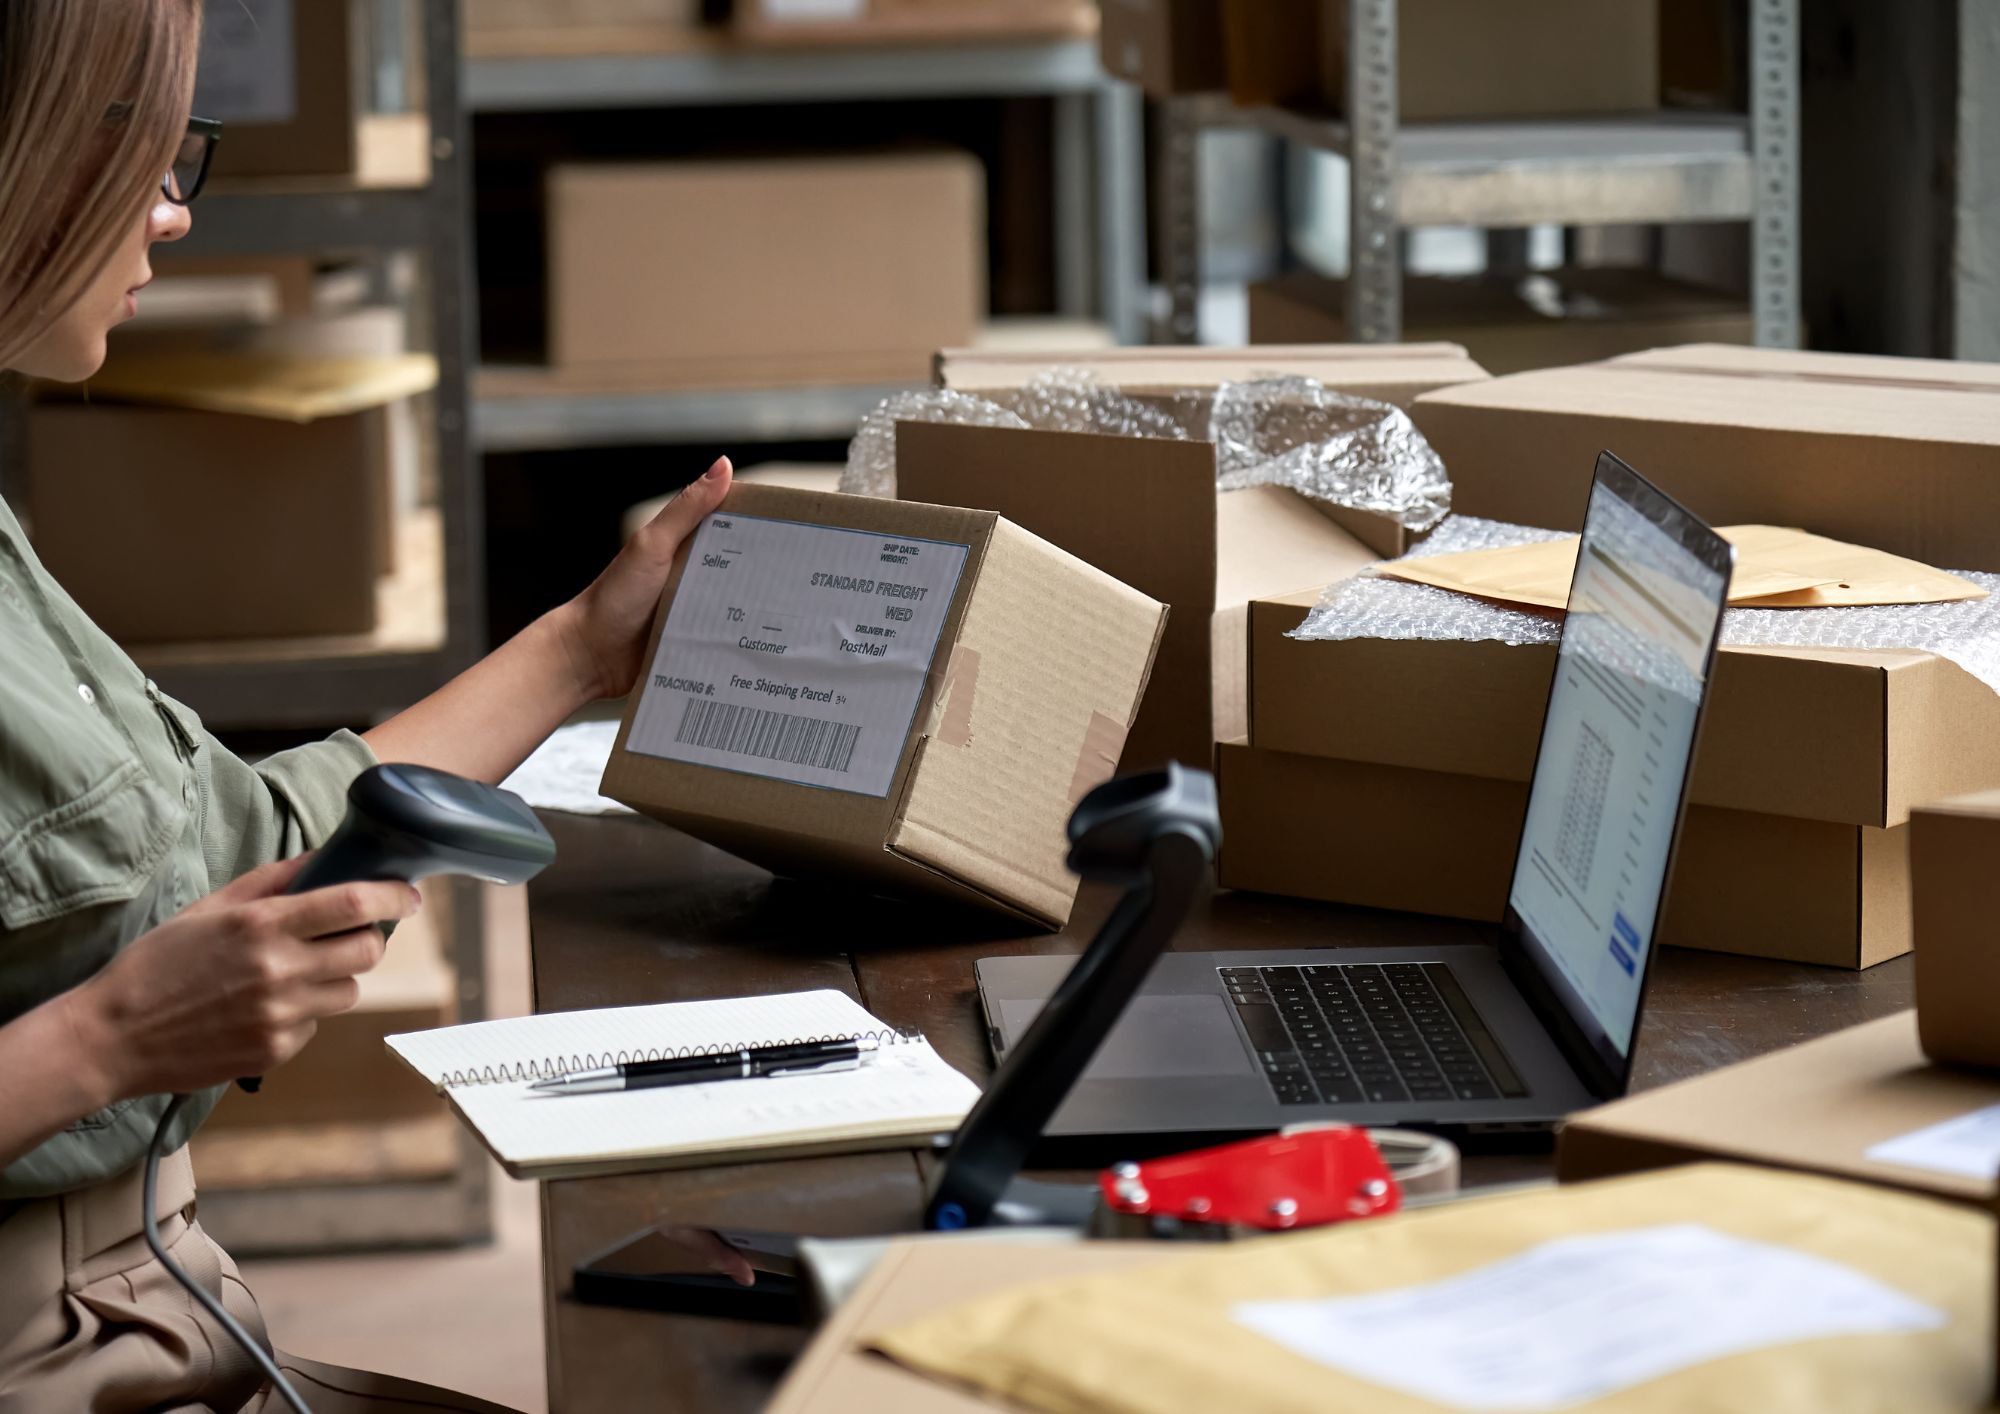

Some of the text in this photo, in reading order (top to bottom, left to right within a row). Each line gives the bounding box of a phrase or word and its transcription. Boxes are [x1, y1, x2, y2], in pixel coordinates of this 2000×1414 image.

[883, 543, 920, 556] SHIP DATE:
[702, 554, 731, 569] Seller
[880, 553, 909, 565] WEIGHT:
[811, 572, 928, 601] STANDARD FREIGHT
[727, 607, 746, 622] TO:
[885, 605, 914, 622] WED
[855, 624, 897, 638] DELIVER BY:
[738, 636, 788, 655] Customer
[839, 639, 888, 657] PostMail
[654, 674, 716, 697] TRACKING #:
[730, 674, 754, 690] Free
[754, 678, 799, 700] Shipping
[800, 686, 834, 703] Parcel
